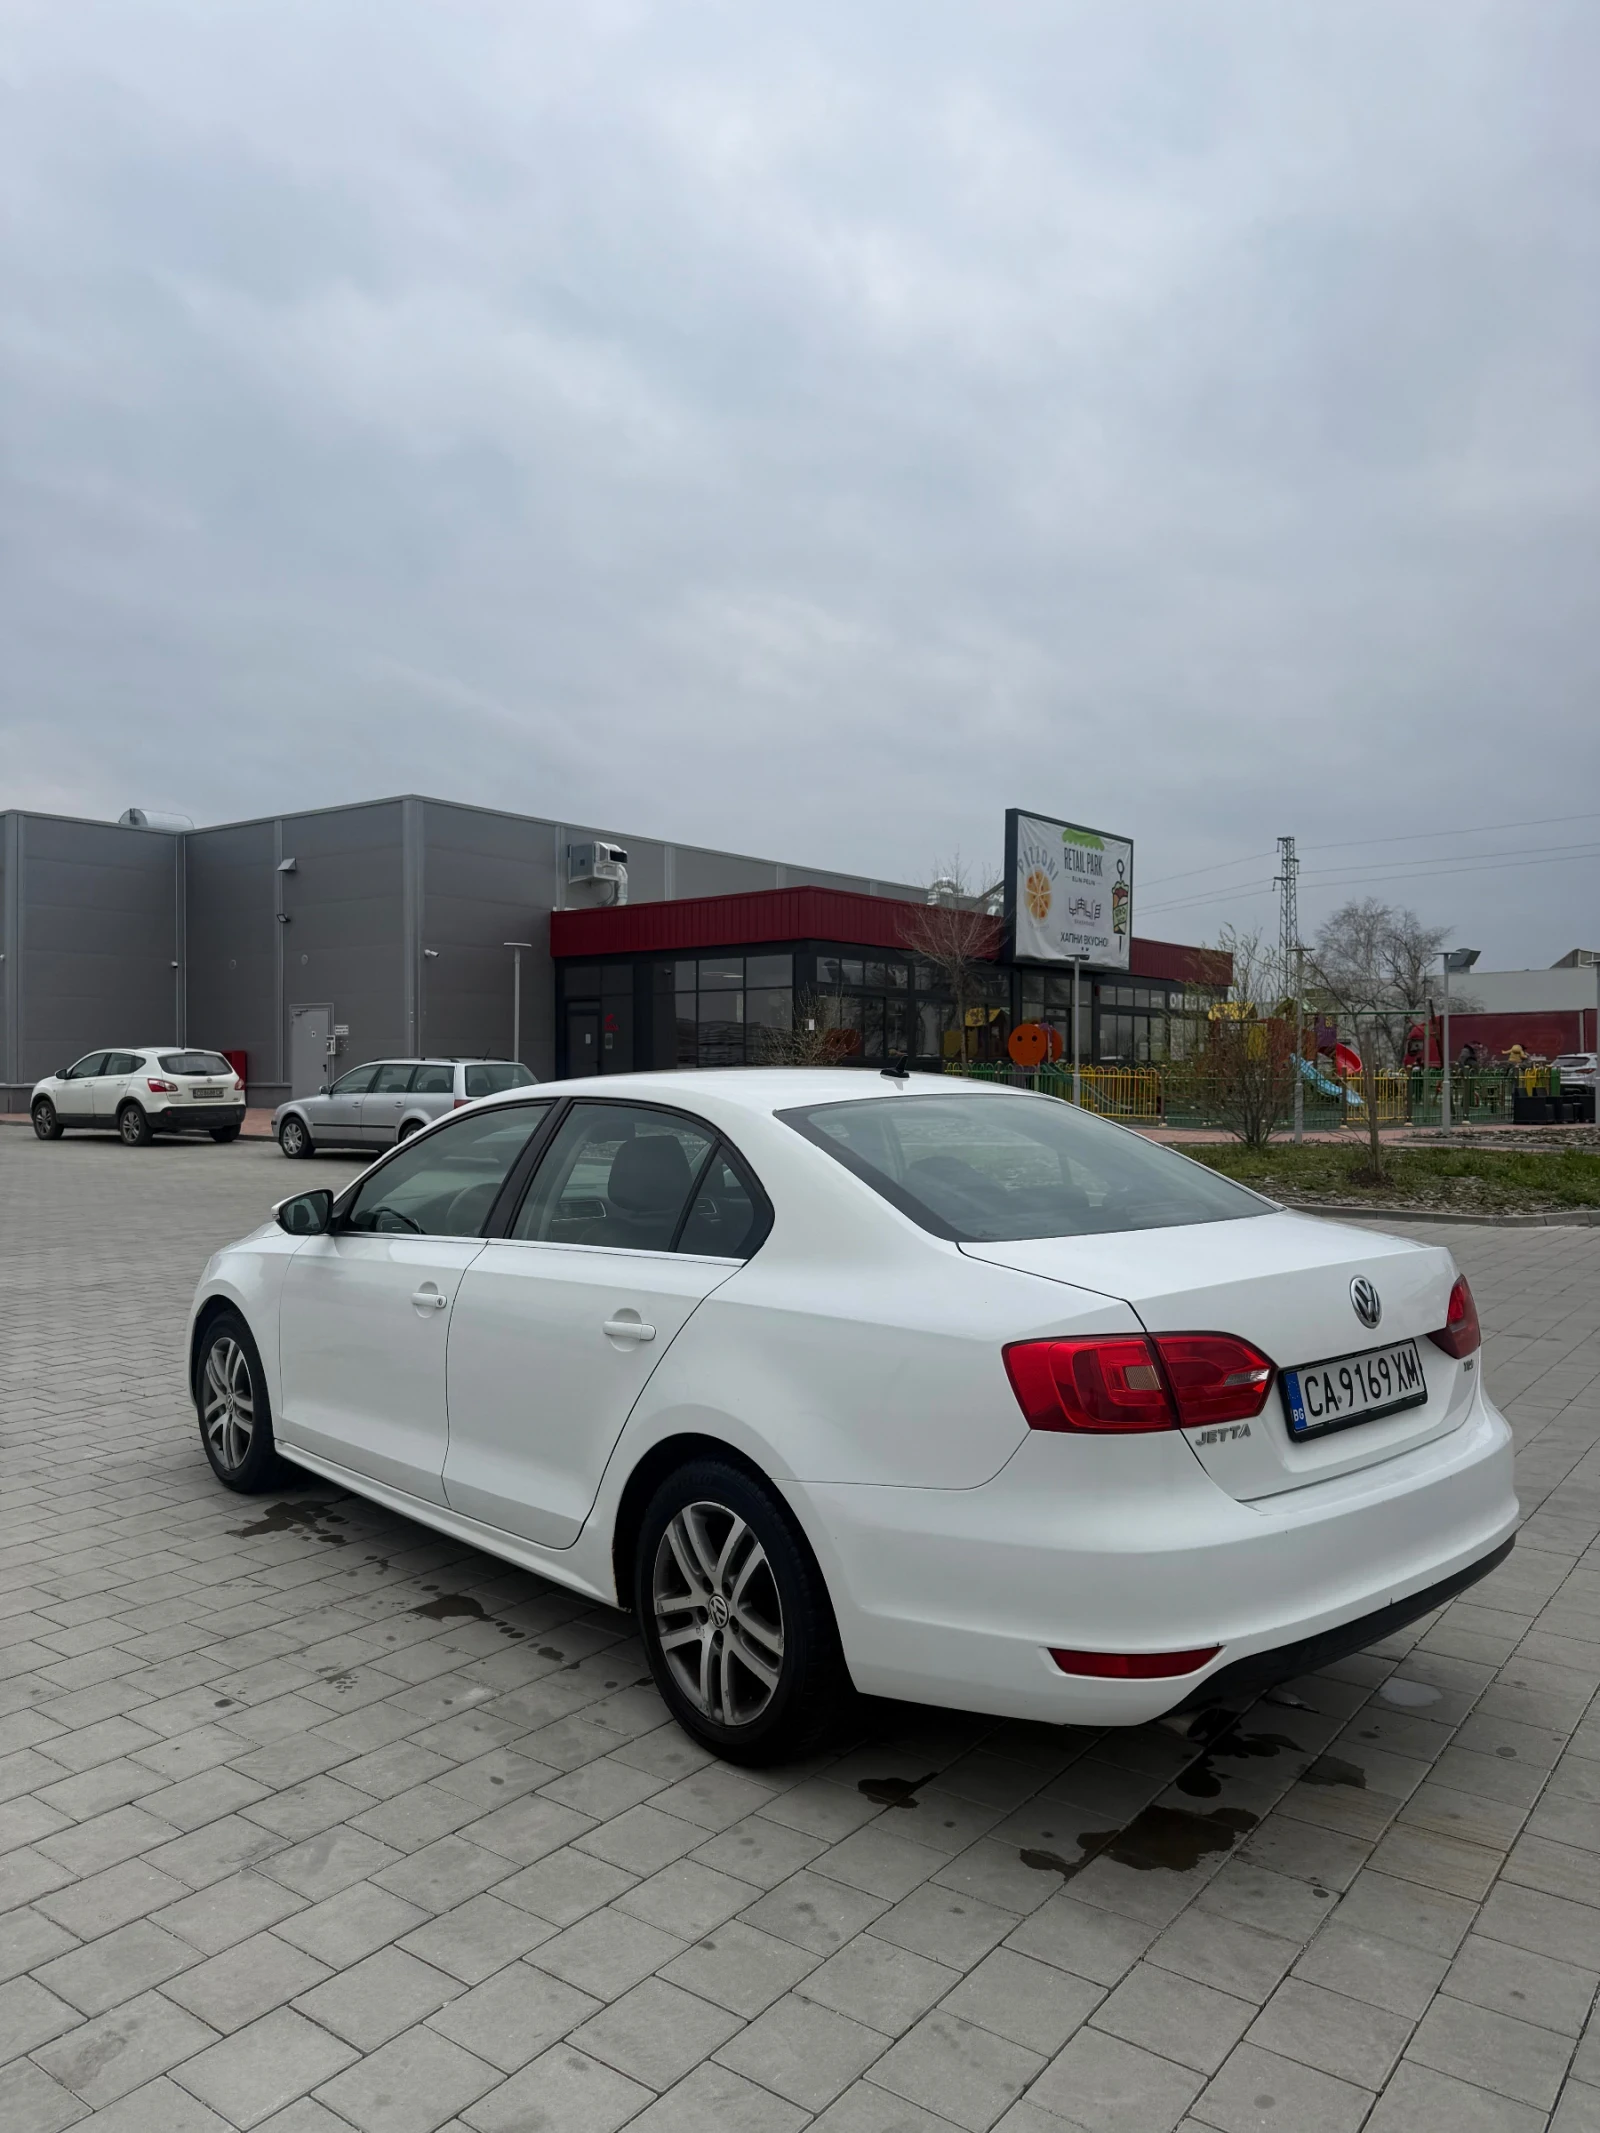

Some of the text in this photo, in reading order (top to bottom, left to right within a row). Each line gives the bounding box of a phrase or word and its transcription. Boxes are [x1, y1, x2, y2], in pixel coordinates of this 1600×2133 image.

[1017, 846, 1059, 882] PIZZONI
[1064, 847, 1103, 877] RETAIL PARK
[1060, 932, 1083, 945] ХАПНИ
[1292, 1408, 1305, 1422] BG
[1195, 1423, 1251, 1446] JETTA
